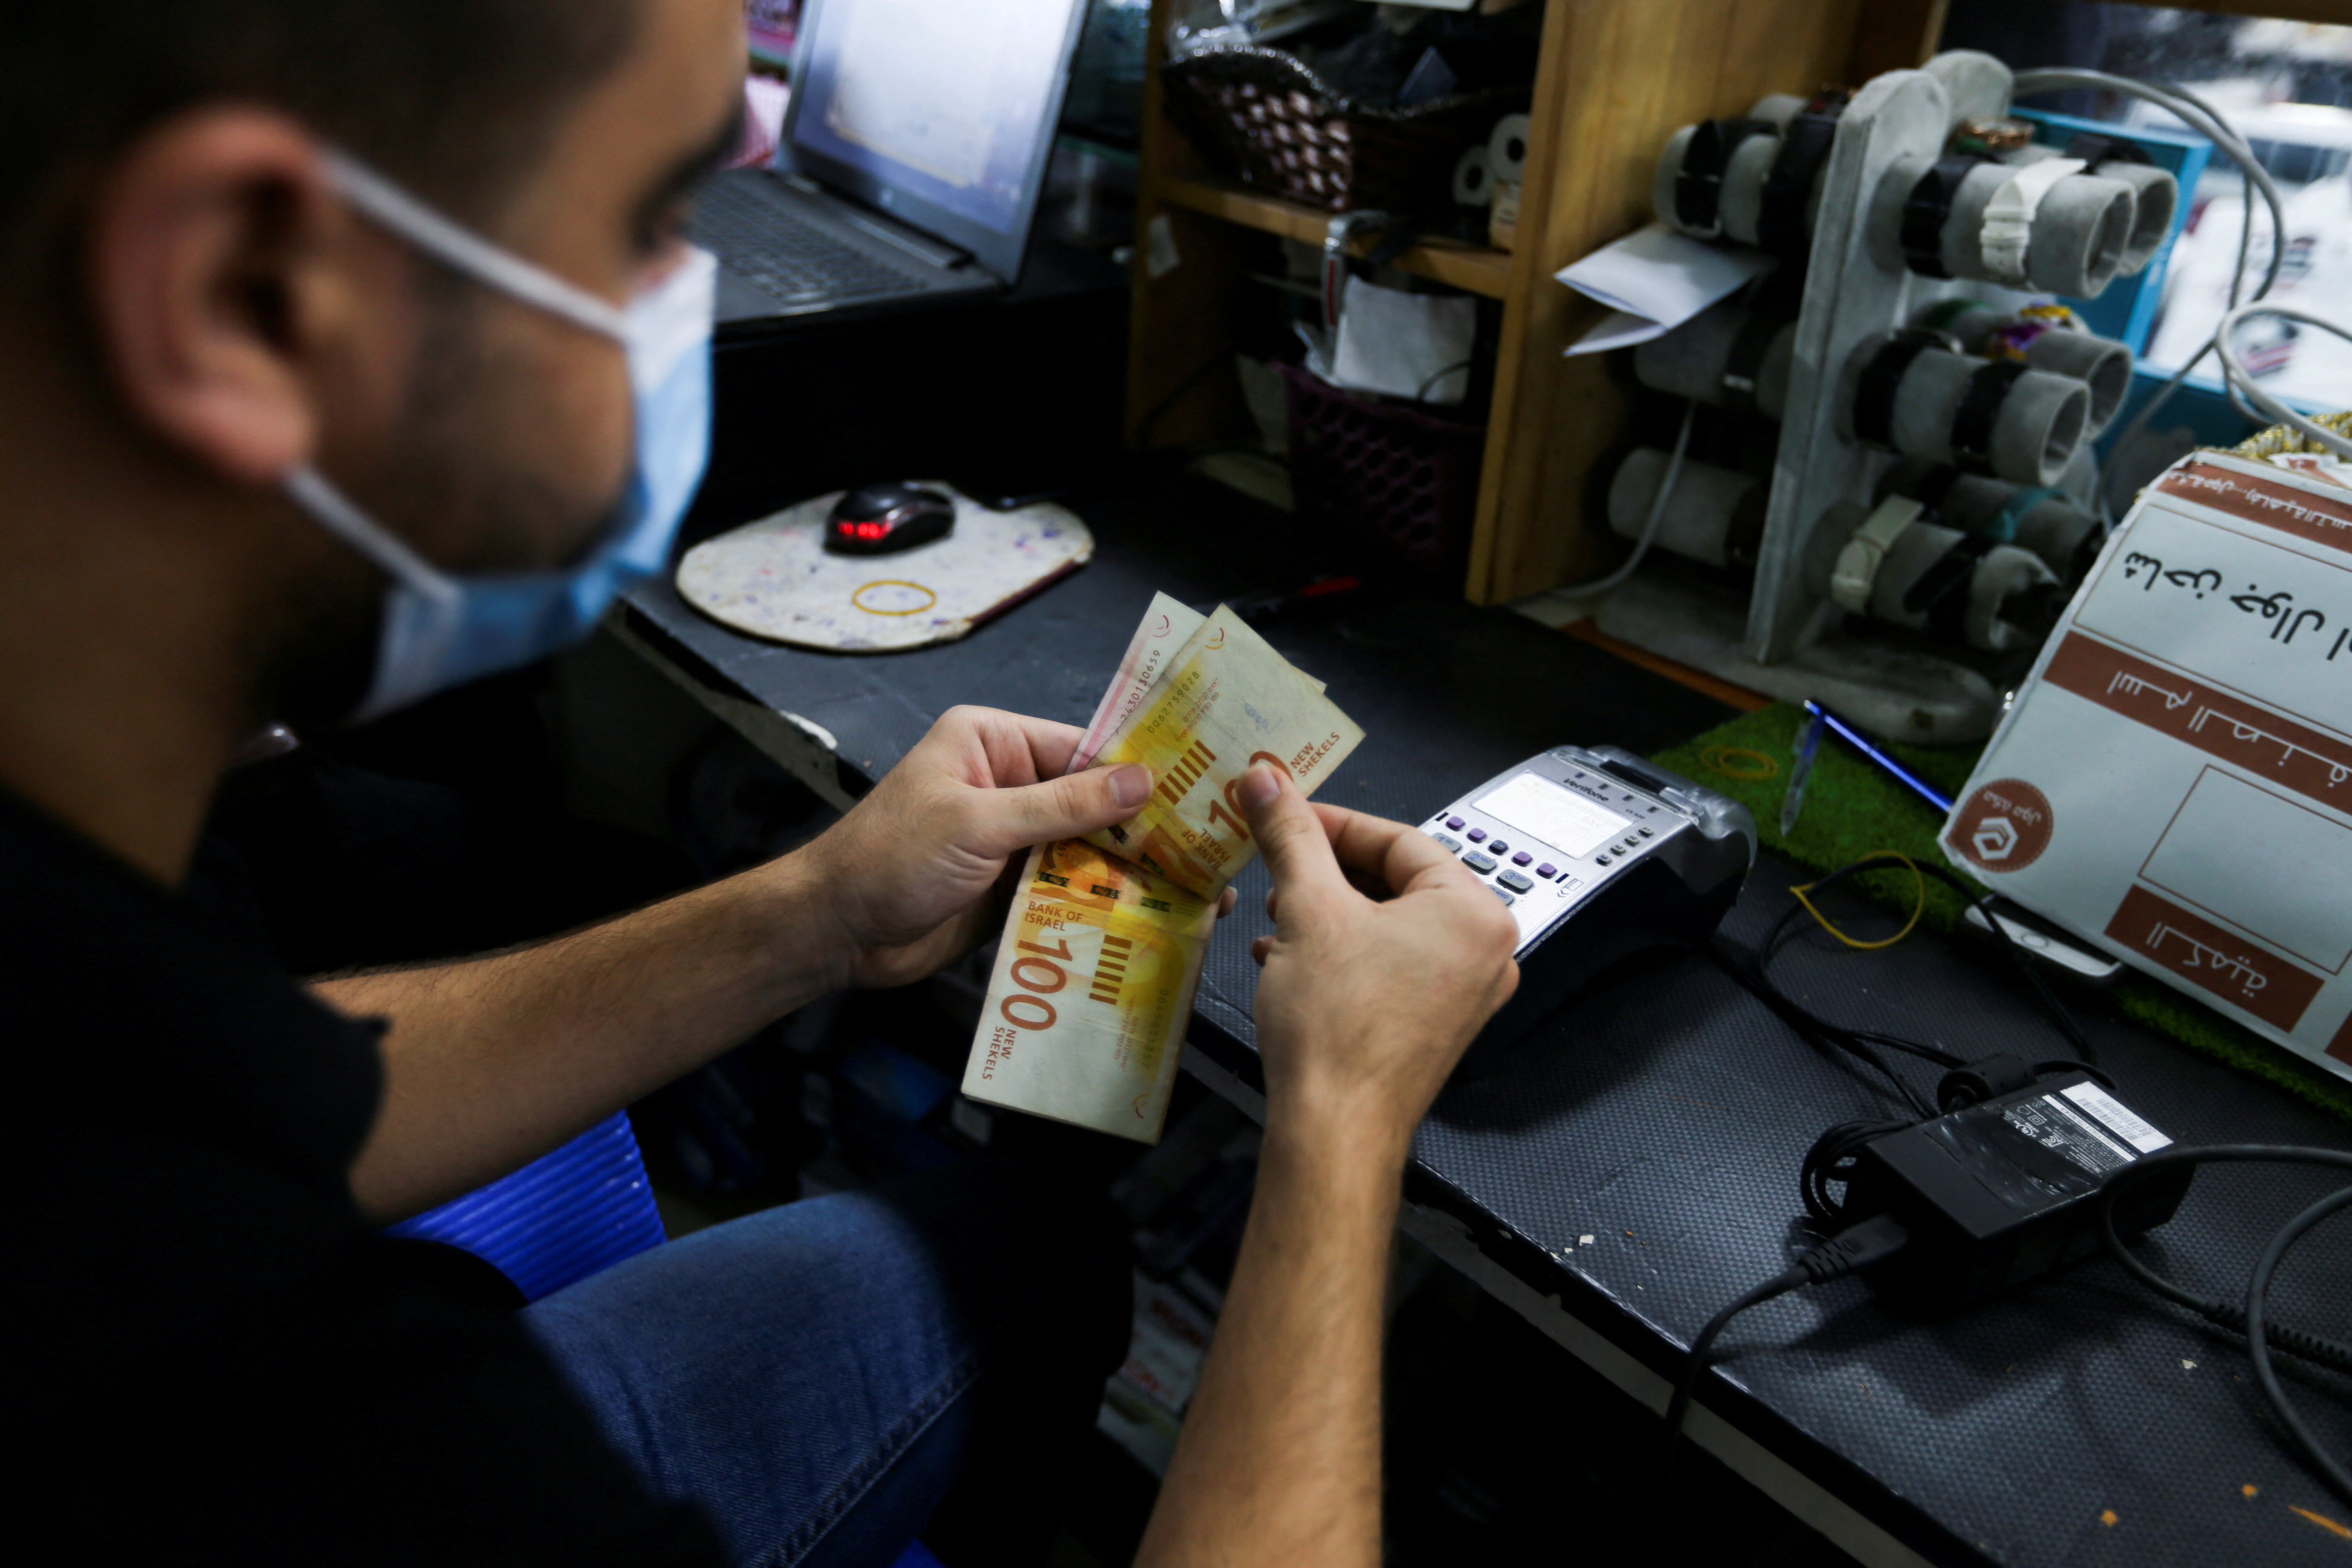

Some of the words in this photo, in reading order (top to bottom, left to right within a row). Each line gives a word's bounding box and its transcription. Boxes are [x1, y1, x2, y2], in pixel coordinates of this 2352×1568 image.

[2125, 551, 2222, 599] شاحن
[2230, 584, 2325, 644] جوال
[1120, 649, 1161, 721] 2430130659
[1146, 669, 1200, 735] 0062759028
[2107, 671, 2192, 710] اسم
[1290, 742, 1315, 770] NEW
[1298, 731, 1340, 777] SHEKELS
[1563, 778, 1609, 803] Verifone
[1983, 790, 2012, 813] مكة
[2013, 805, 2042, 827] مول
[1181, 828, 1196, 843] OF
[1200, 828, 1230, 862] ISRAEL
[1196, 842, 1220, 870] BANK
[1469, 852, 1479, 862] 2
[1479, 856, 1491, 865] ABC
[1504, 870, 1515, 881] 3
[1515, 874, 1527, 883] DEF
[1025, 912, 1066, 931] ISRAEL
[1028, 901, 1061, 918] BANK
[1067, 910, 1083, 922] OF
[2146, 922, 2267, 998] الكمية
[1000, 939, 1073, 1030] 100
[982, 1026, 1005, 1080] SHEKELS
[1000, 1029, 1016, 1059] NEW
